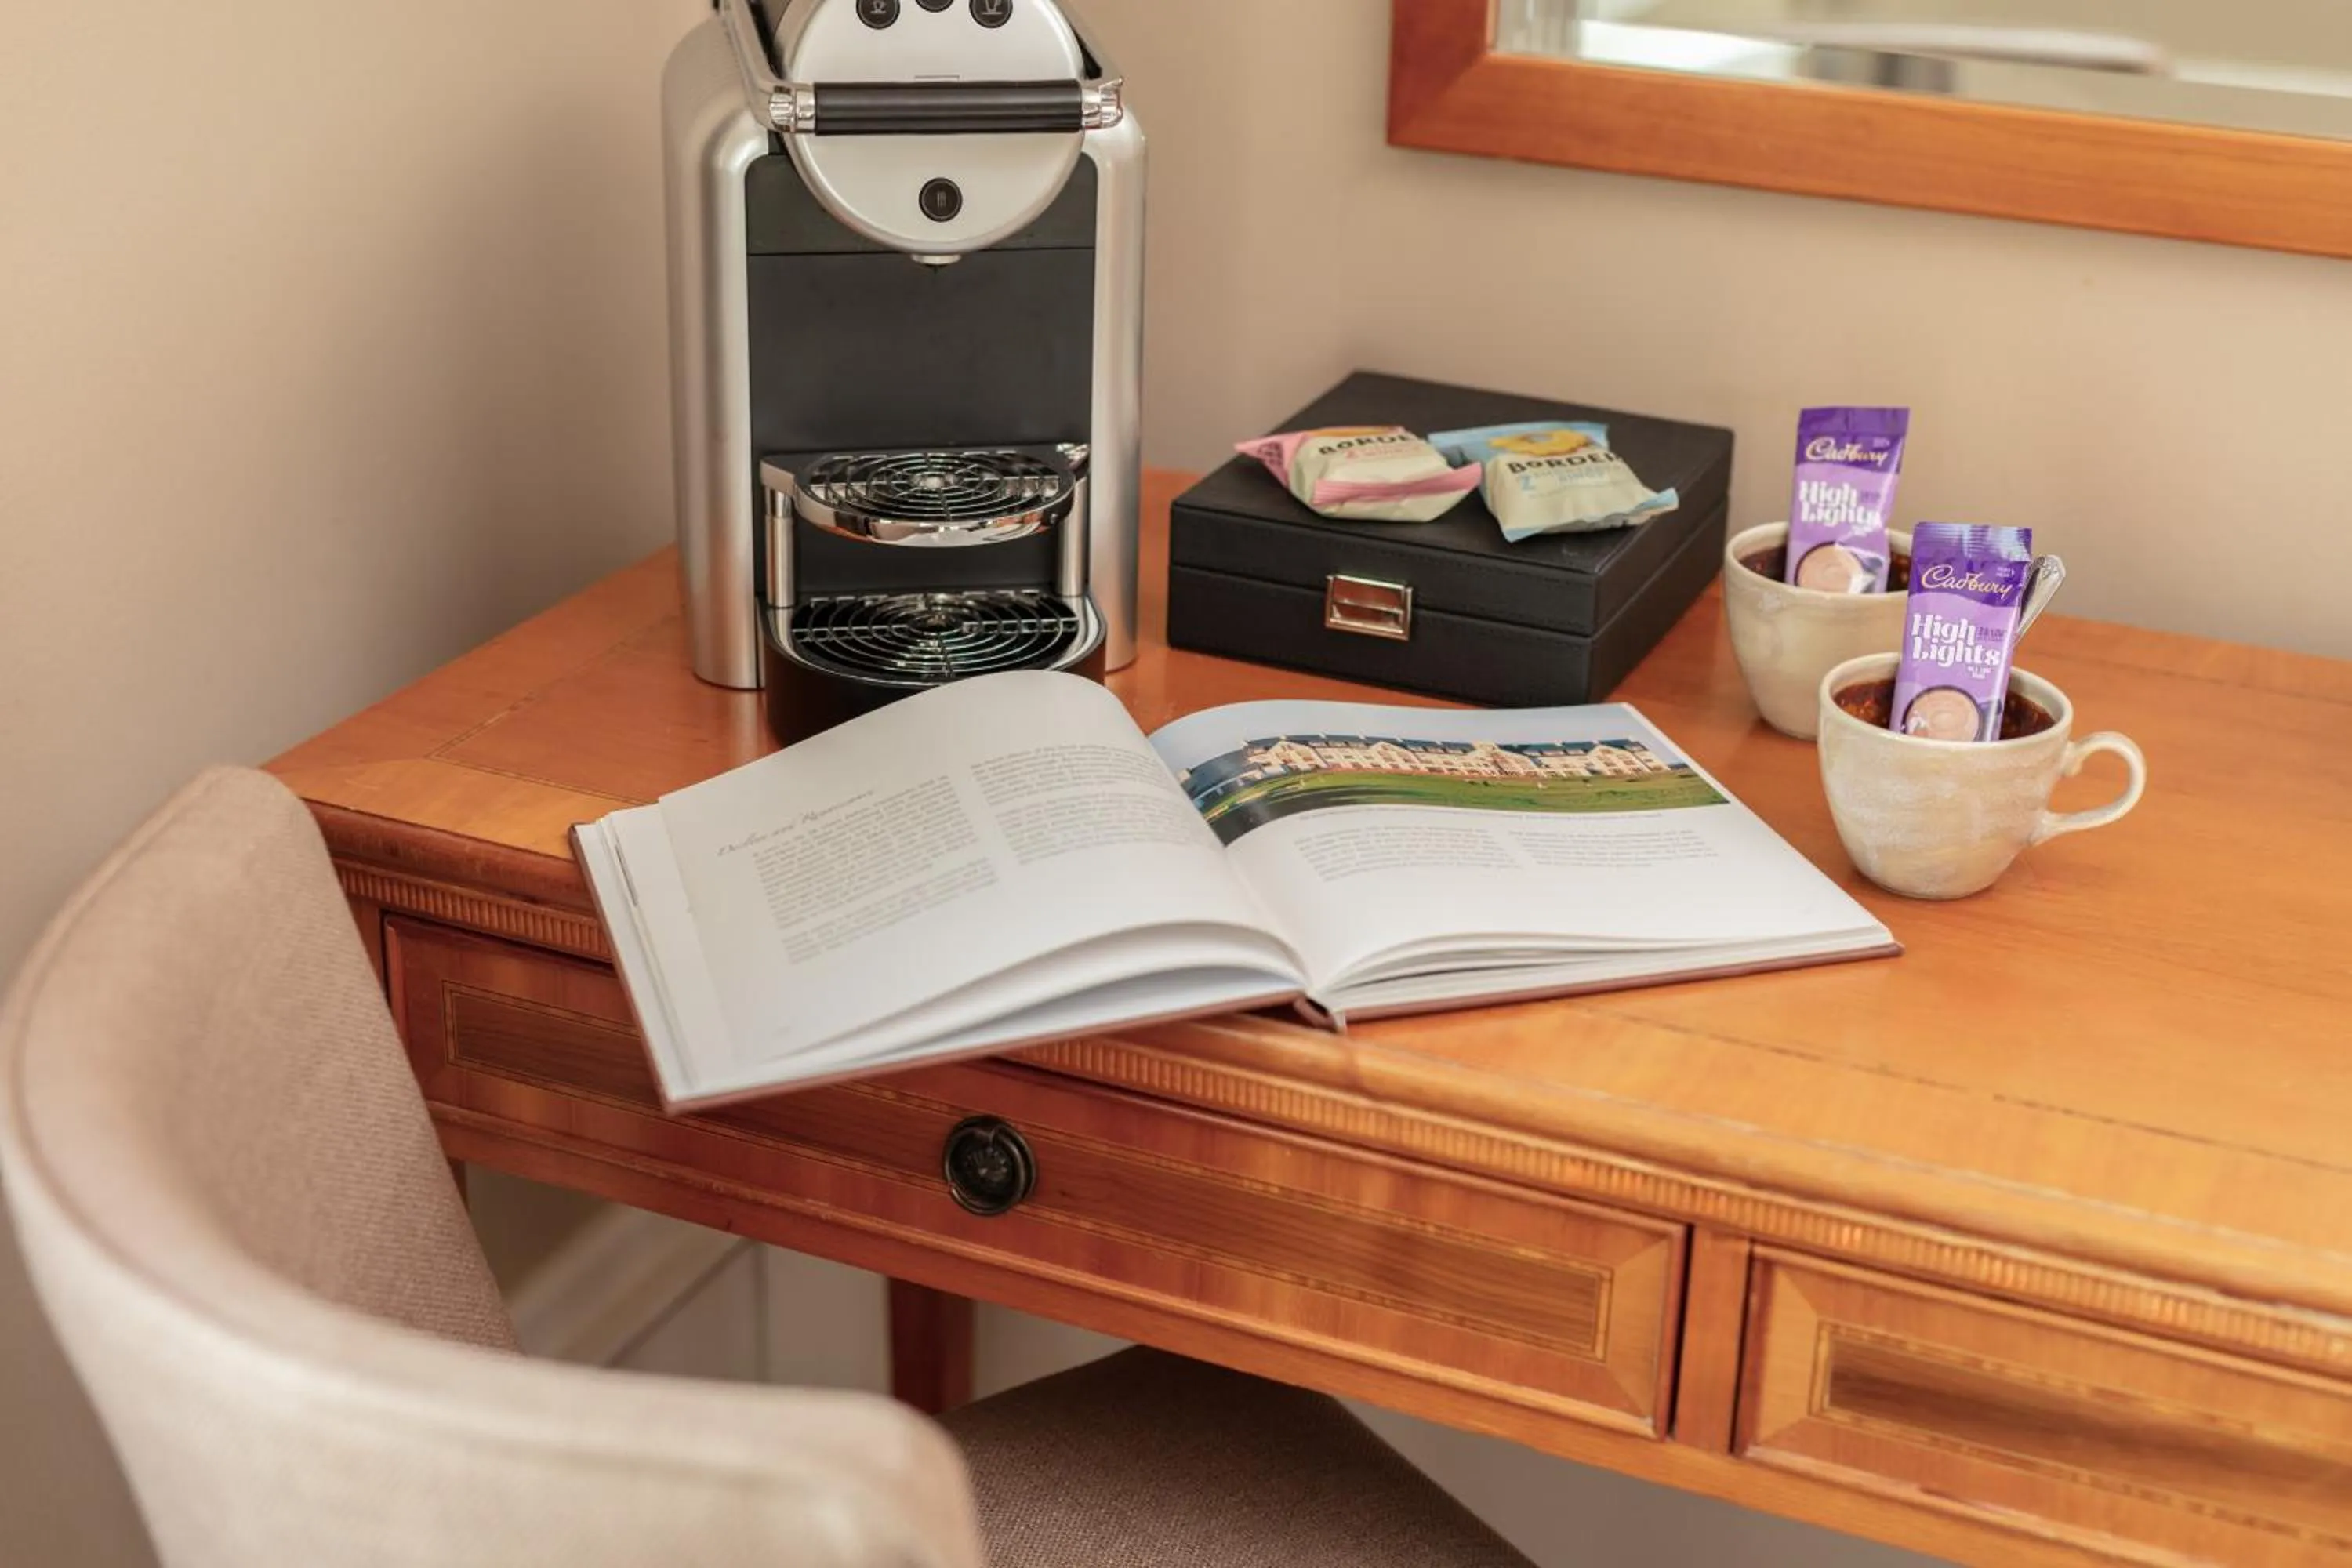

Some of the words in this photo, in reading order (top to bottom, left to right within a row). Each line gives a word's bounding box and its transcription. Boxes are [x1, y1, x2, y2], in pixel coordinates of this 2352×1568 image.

[1318, 434, 1411, 456] BORDE
[1806, 437, 1889, 466] Cadbury
[1798, 480, 1857, 508] High
[1800, 503, 1882, 527] Lights
[1922, 564, 2013, 600] Cadbury
[1911, 613, 1976, 647] High
[1912, 637, 2001, 668] Lights
